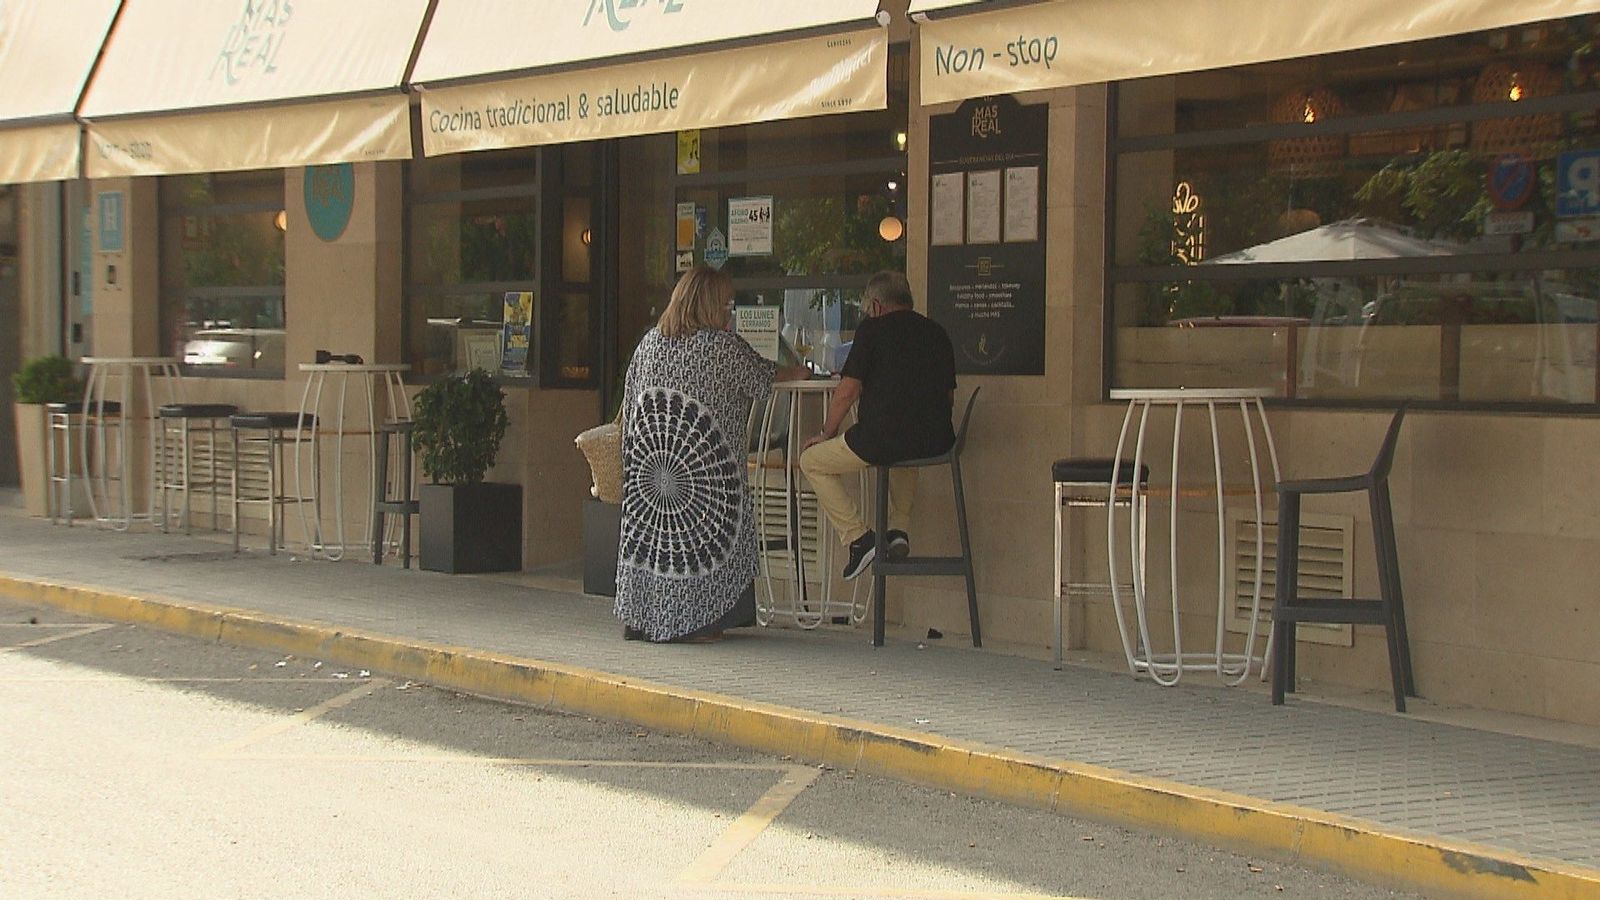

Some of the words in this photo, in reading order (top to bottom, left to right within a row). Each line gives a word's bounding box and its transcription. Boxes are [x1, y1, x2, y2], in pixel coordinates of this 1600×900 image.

[208, 22, 285, 85] REAL
[935, 44, 985, 76] Non
[1006, 34, 1058, 70] stop
[429, 106, 482, 133] Cocina
[486, 94, 571, 128] tradicional
[578, 92, 590, 119] &
[597, 81, 679, 117] saludable
[974, 105, 998, 120] MAS
[971, 116, 1001, 138] REAL
[749, 209, 759, 222] 45
[740, 310, 753, 319] LOS
[754, 310, 774, 319] LUNES
